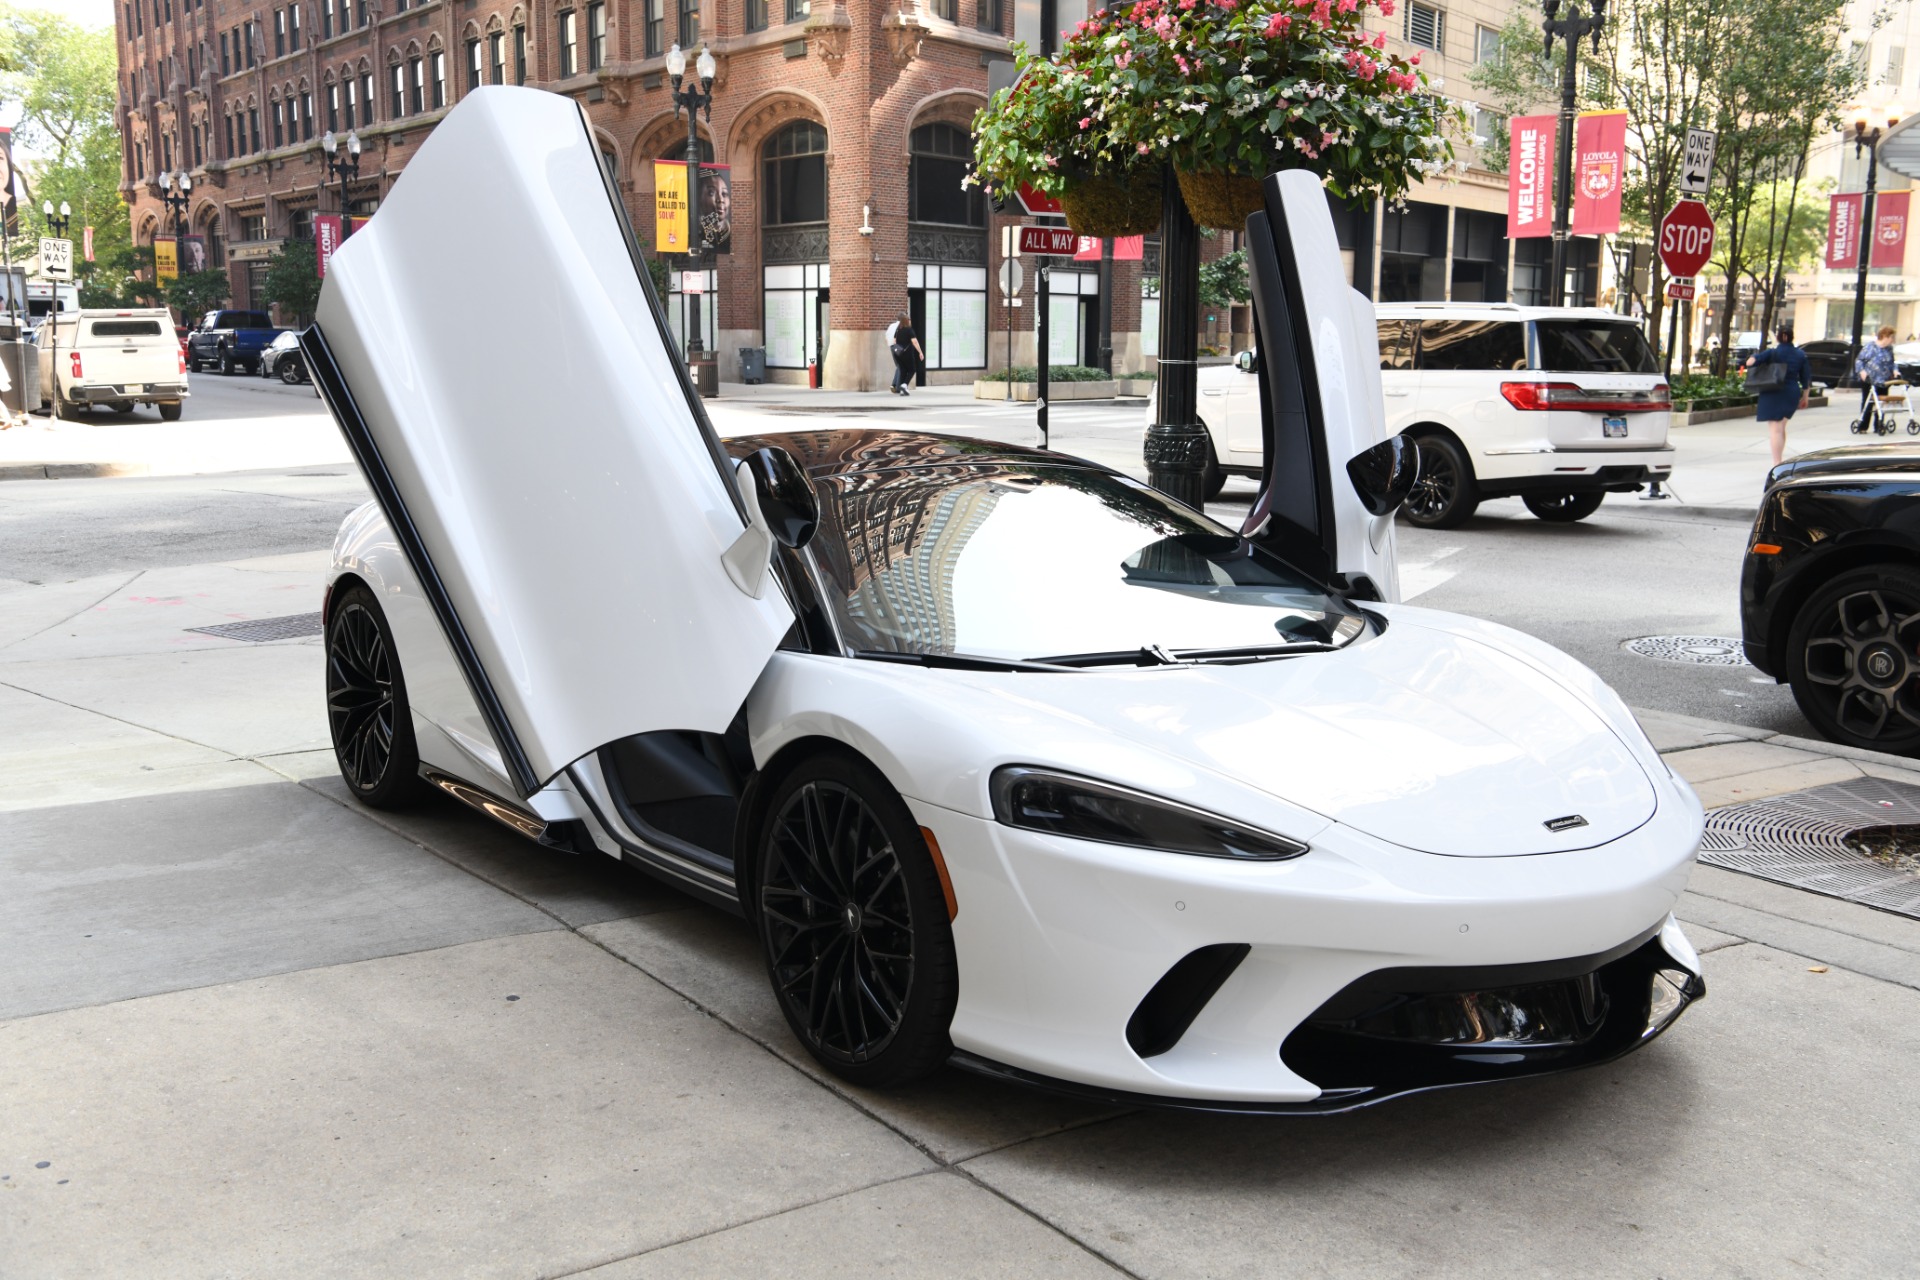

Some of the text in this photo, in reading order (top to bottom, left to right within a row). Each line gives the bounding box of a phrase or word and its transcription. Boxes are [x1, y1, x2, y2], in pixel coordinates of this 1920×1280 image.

[1689, 134, 1711, 151] ONE
[1582, 151, 1618, 161] LOYOLA
[1686, 152, 1710, 168] WAY
[1517, 129, 1537, 225] WELCOME
[1536, 134, 1547, 219] WATER TOWER CAMPUS
[658, 190, 678, 199] WE ARE
[658, 201, 686, 210] CALLED TO
[658, 211, 675, 219] SOLVE
[1832, 201, 1849, 261] WELCOME
[1025, 232, 1047, 249] ALL
[1051, 233, 1074, 250] WAY
[1663, 223, 1711, 255] STOP
[44, 241, 67, 253] ONE
[44, 253, 68, 264] WAY
[1670, 285, 1693, 298] ALL WAY
